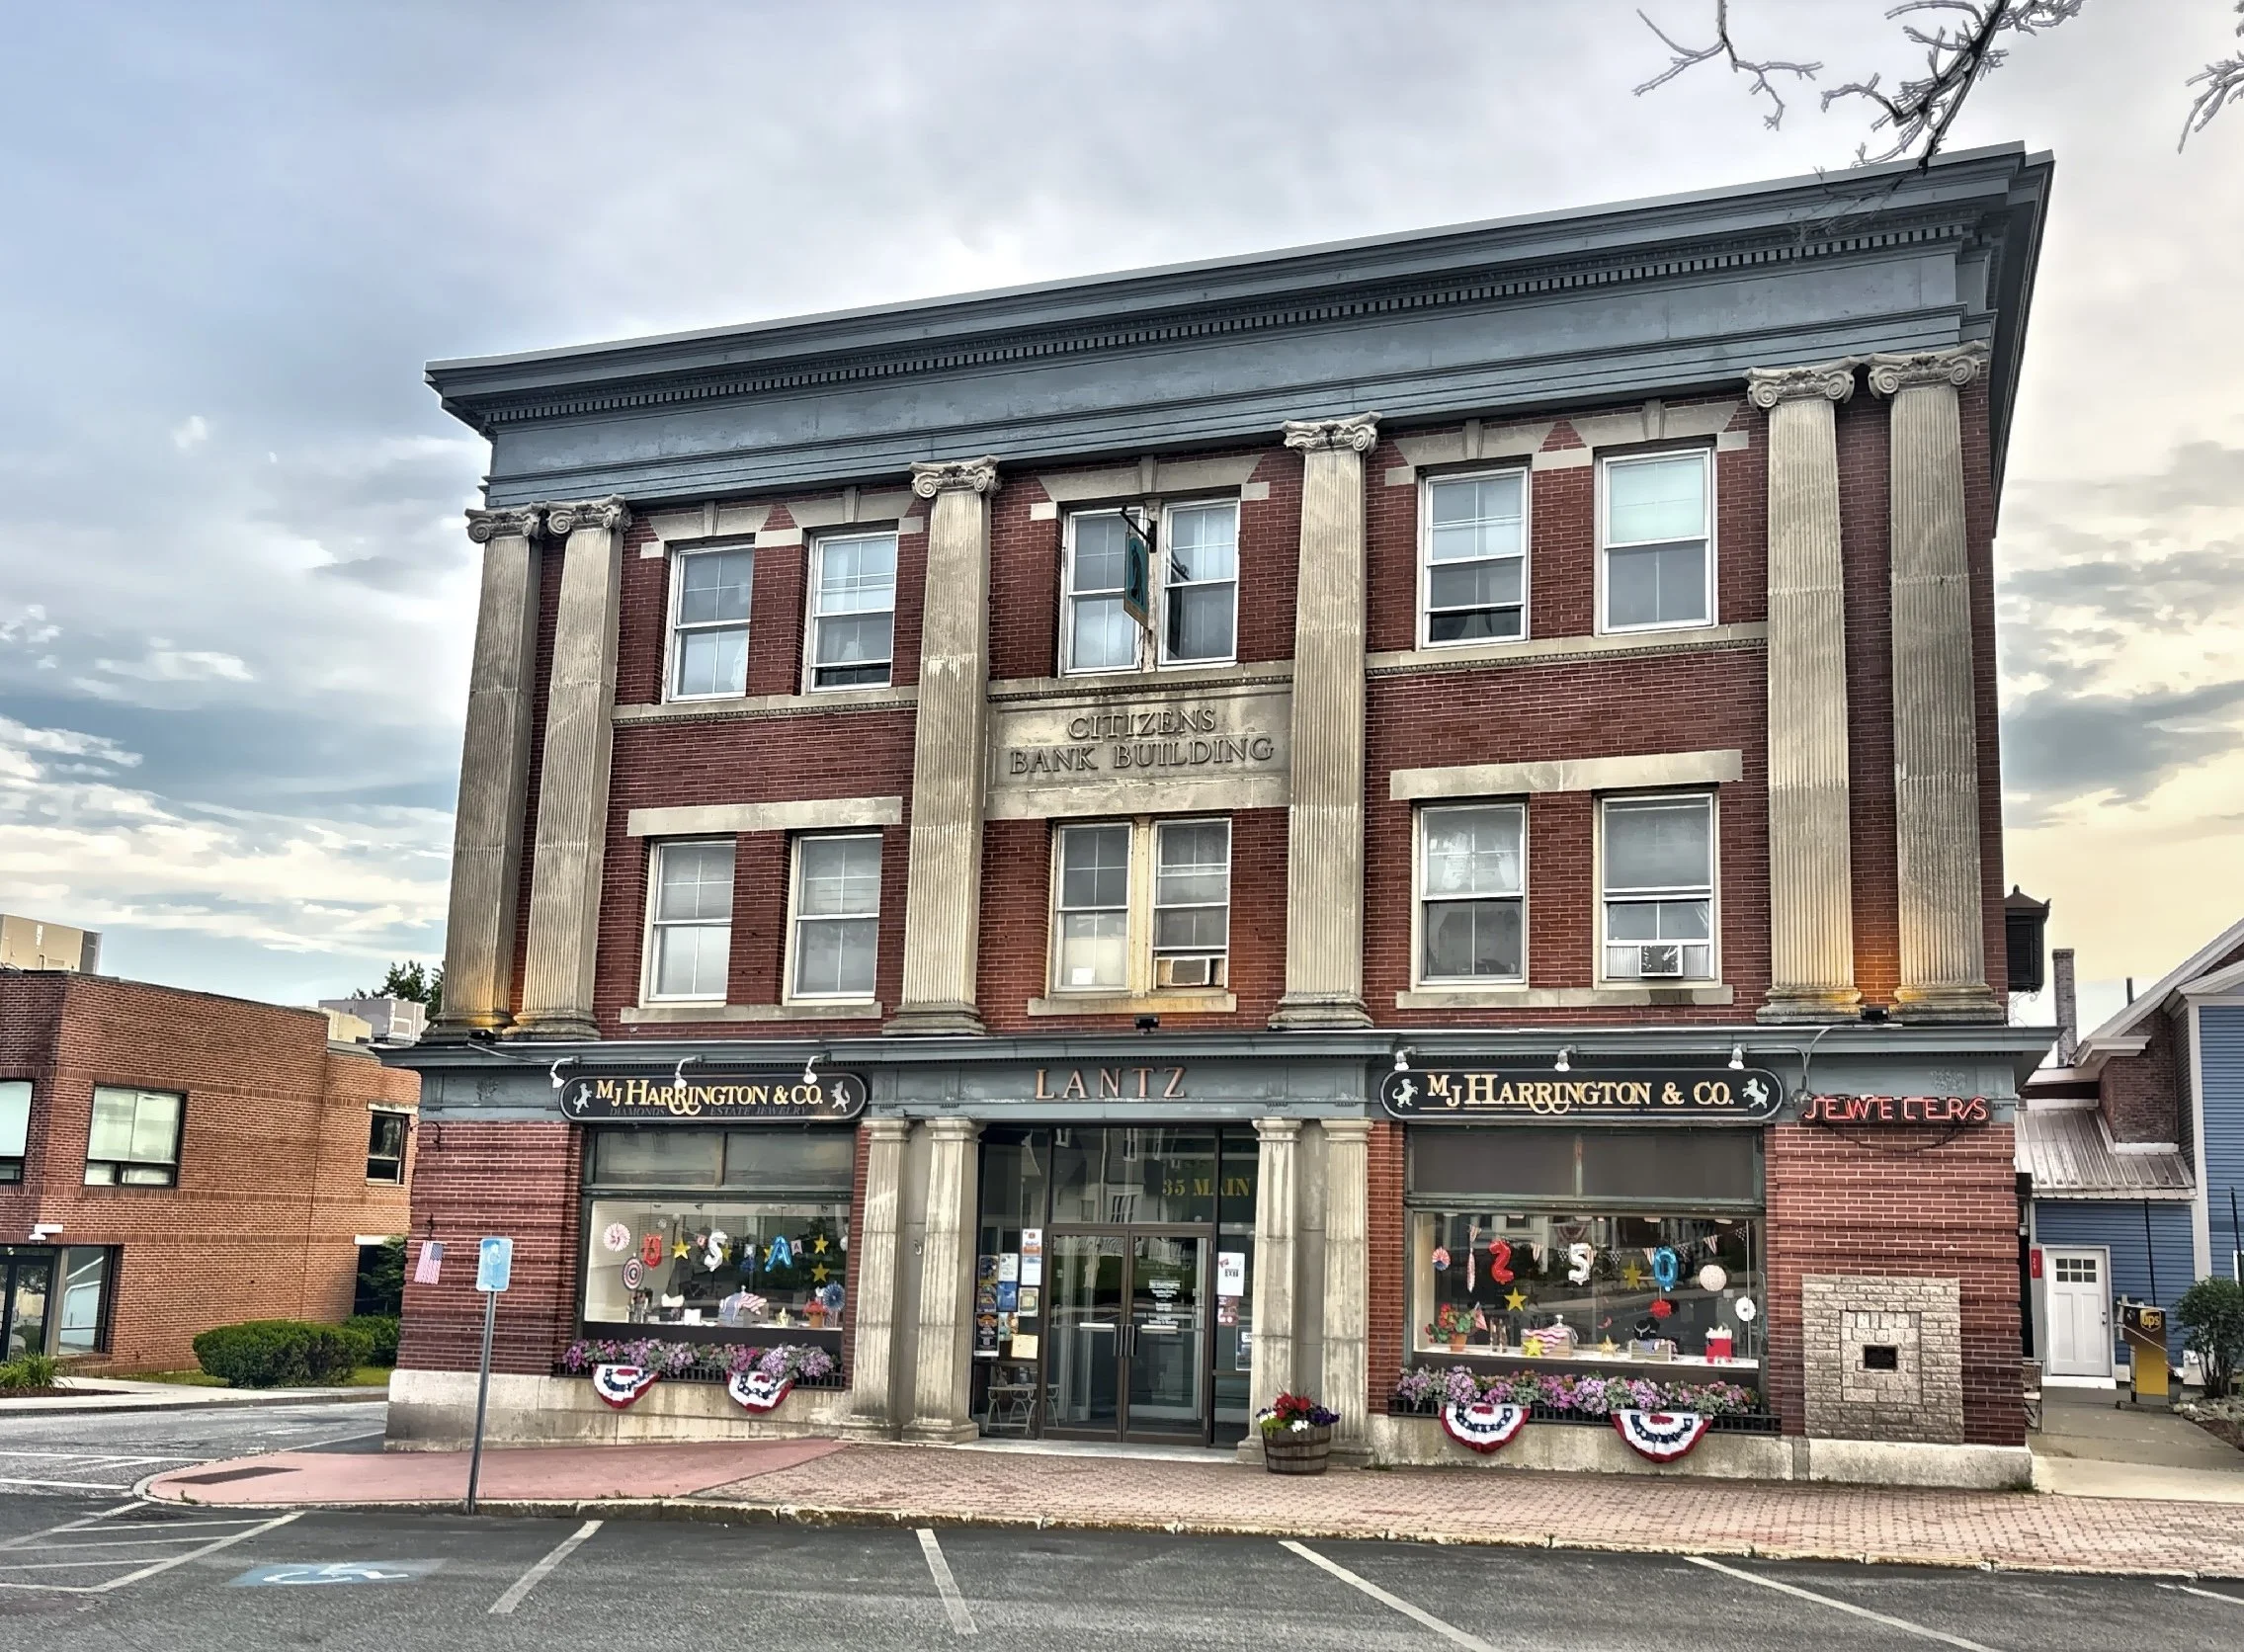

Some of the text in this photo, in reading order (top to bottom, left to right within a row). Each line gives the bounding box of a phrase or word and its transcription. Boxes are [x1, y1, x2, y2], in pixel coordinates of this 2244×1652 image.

[1067, 708, 1216, 740] CITIZENS
[1010, 736, 1275, 775] BANK BUILDING
[773, 1085, 789, 1105] &
[1036, 1066, 1186, 1100] LANTZ
[1661, 1082, 1685, 1105] &
[1693, 1081, 1735, 1105] CO.
[609, 1107, 666, 1116] DIAMONDS
[709, 1107, 751, 1115] ESTATE
[1803, 1096, 1990, 1120] JEWELERS
[1162, 1179, 1186, 1196] 35
